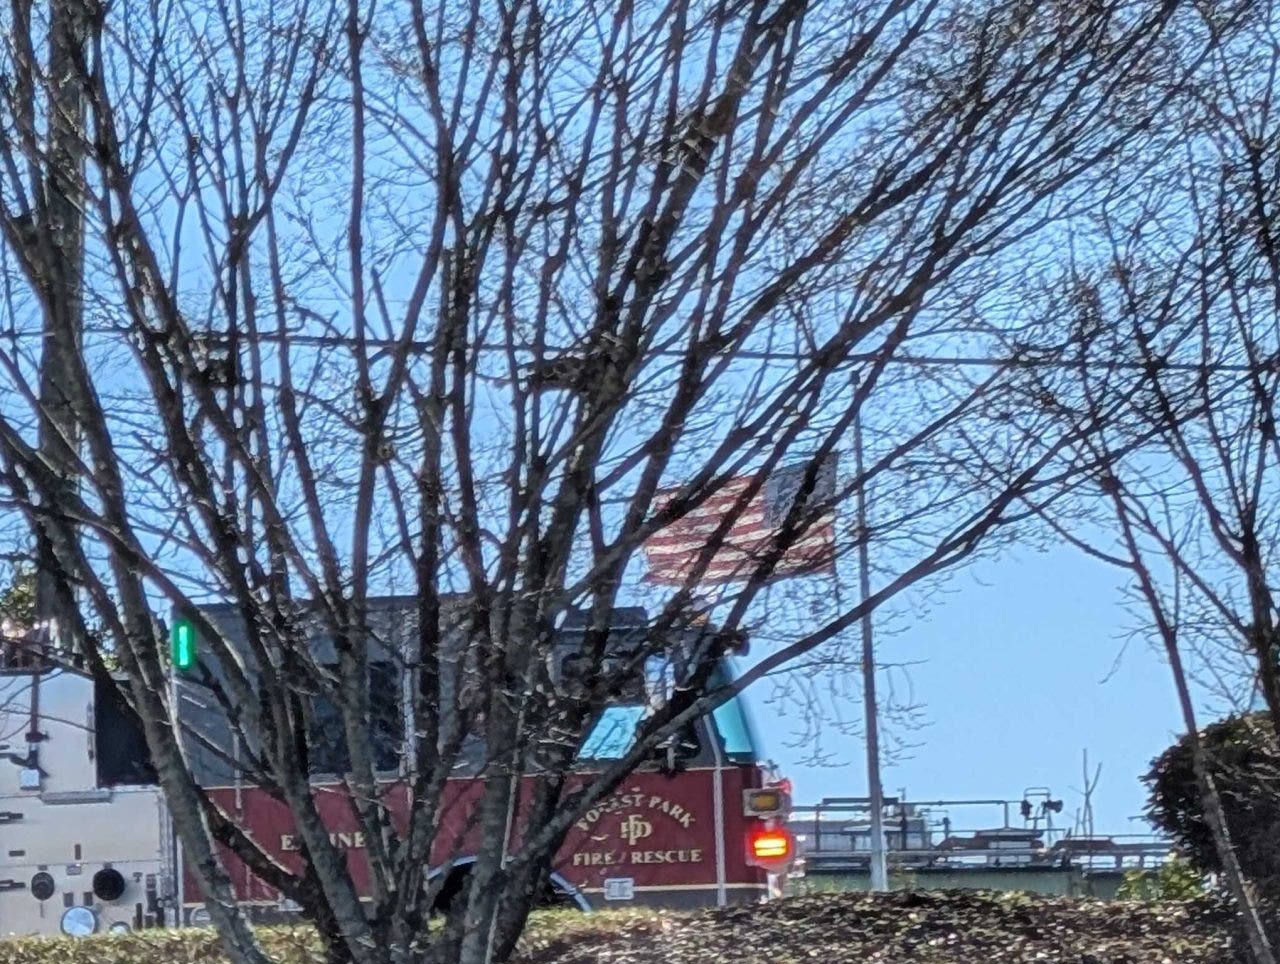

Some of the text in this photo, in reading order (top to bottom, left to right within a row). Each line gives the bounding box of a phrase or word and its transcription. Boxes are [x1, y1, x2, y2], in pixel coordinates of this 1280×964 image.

[648, 796, 696, 829] PARK
[280, 831, 367, 851] EINE
[572, 851, 616, 866] FIRE
[631, 849, 703, 865] RESCUE
